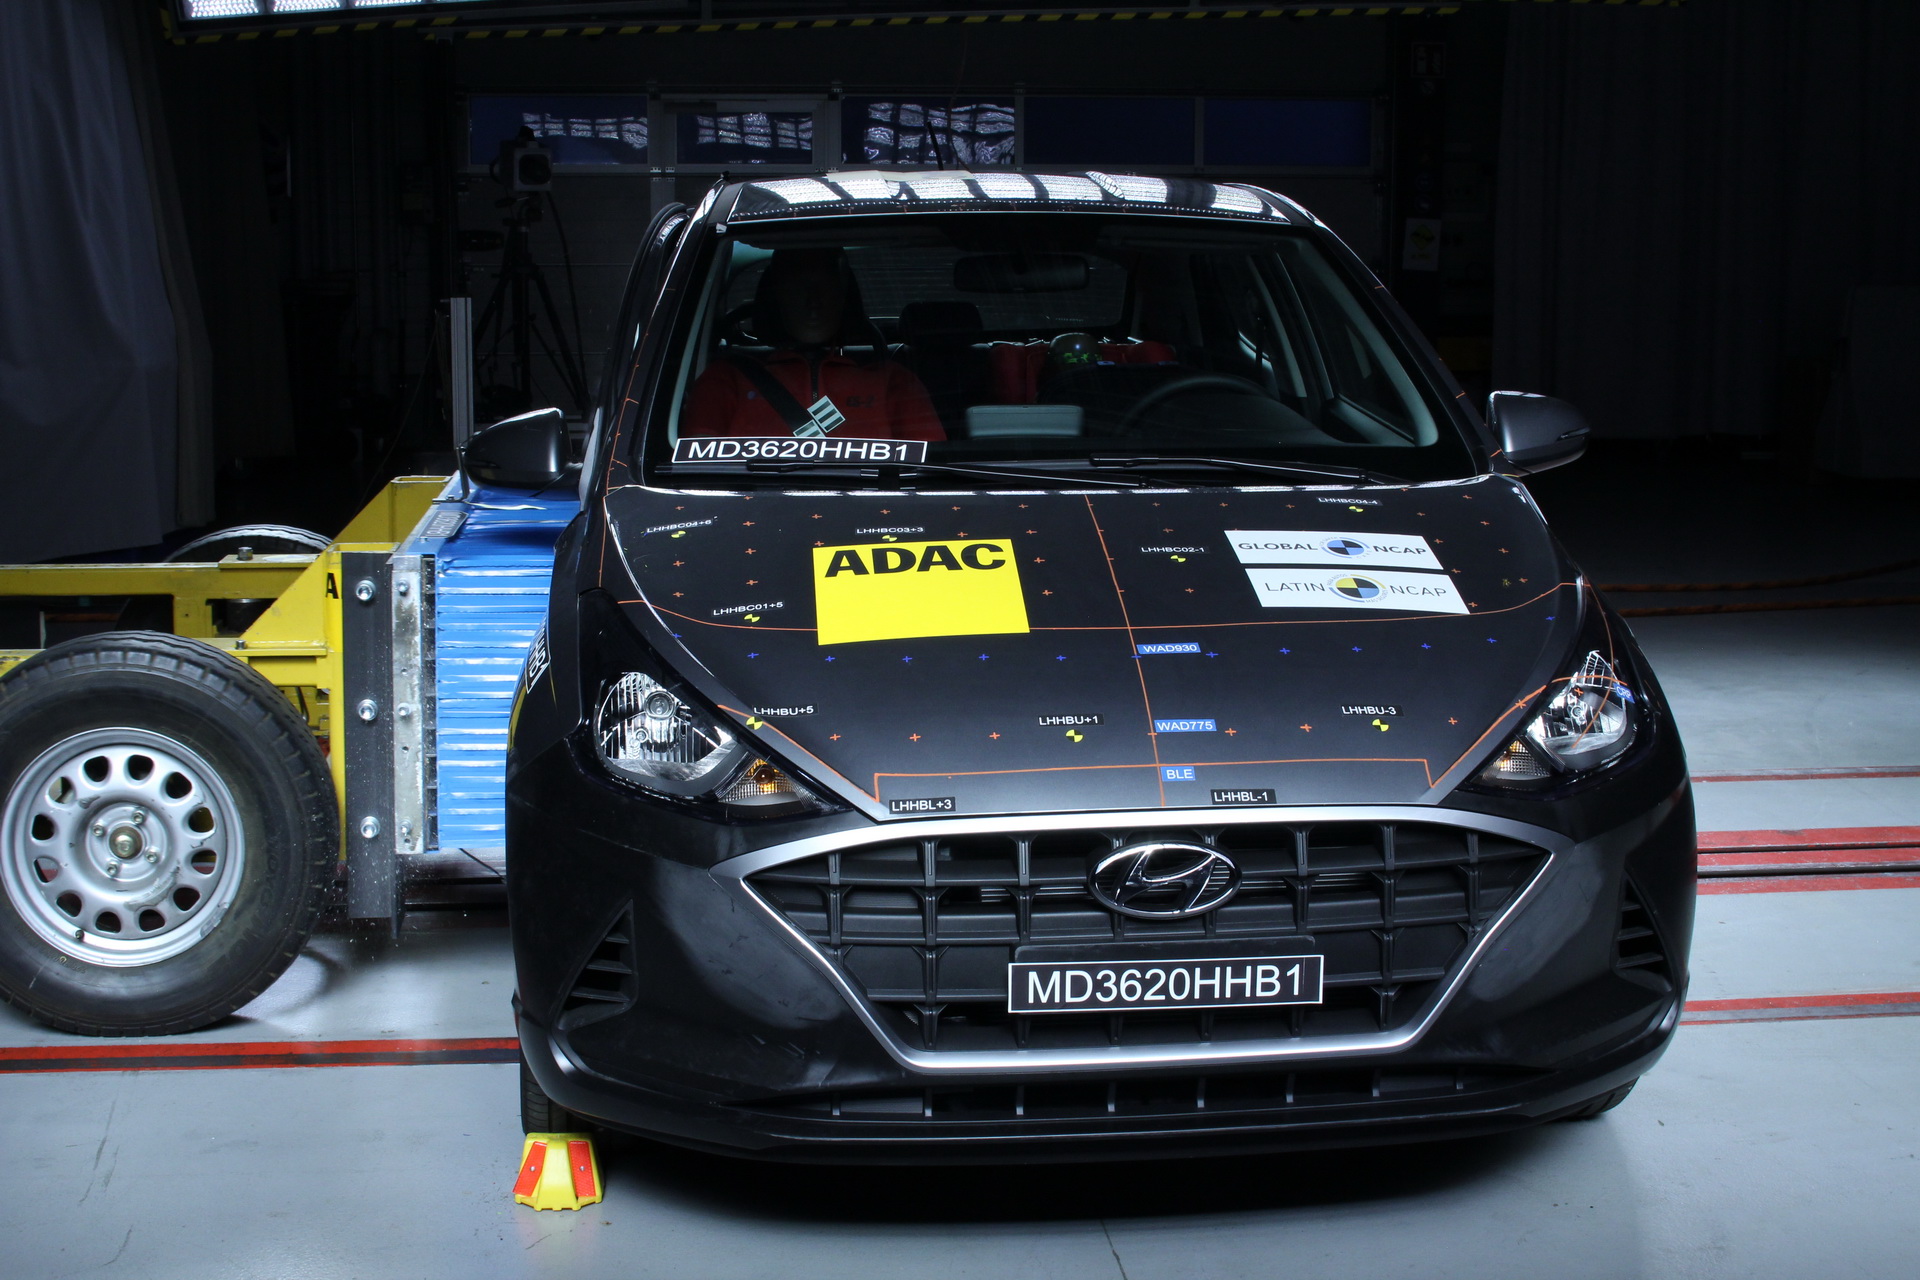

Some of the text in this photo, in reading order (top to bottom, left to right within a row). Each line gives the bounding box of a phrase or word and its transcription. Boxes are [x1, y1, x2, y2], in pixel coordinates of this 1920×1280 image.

[687, 441, 909, 461] MD3620HHB1
[645, 518, 713, 534] LHHBC04+6
[856, 526, 925, 535] LHHBC03+3
[1237, 542, 1319, 553] GLOBAL
[1372, 545, 1428, 557] NCAP
[824, 543, 1006, 578] ADAC
[325, 572, 339, 600] A
[1264, 582, 1326, 593] LATIN
[1389, 585, 1448, 598] NCAP
[712, 601, 784, 616] LHHBC01+5
[1142, 643, 1198, 653] WAD930
[753, 705, 815, 717] LHHBU+5
[1341, 704, 1398, 717] LHHBU-3
[1038, 714, 1100, 726] LHHBU+1
[1156, 719, 1214, 732] WAD775
[1166, 767, 1194, 781] BLE
[1213, 790, 1269, 803] LHHBL-1
[891, 799, 953, 813] LHHBL+3
[1027, 964, 1304, 1004] MD3620HHB1
